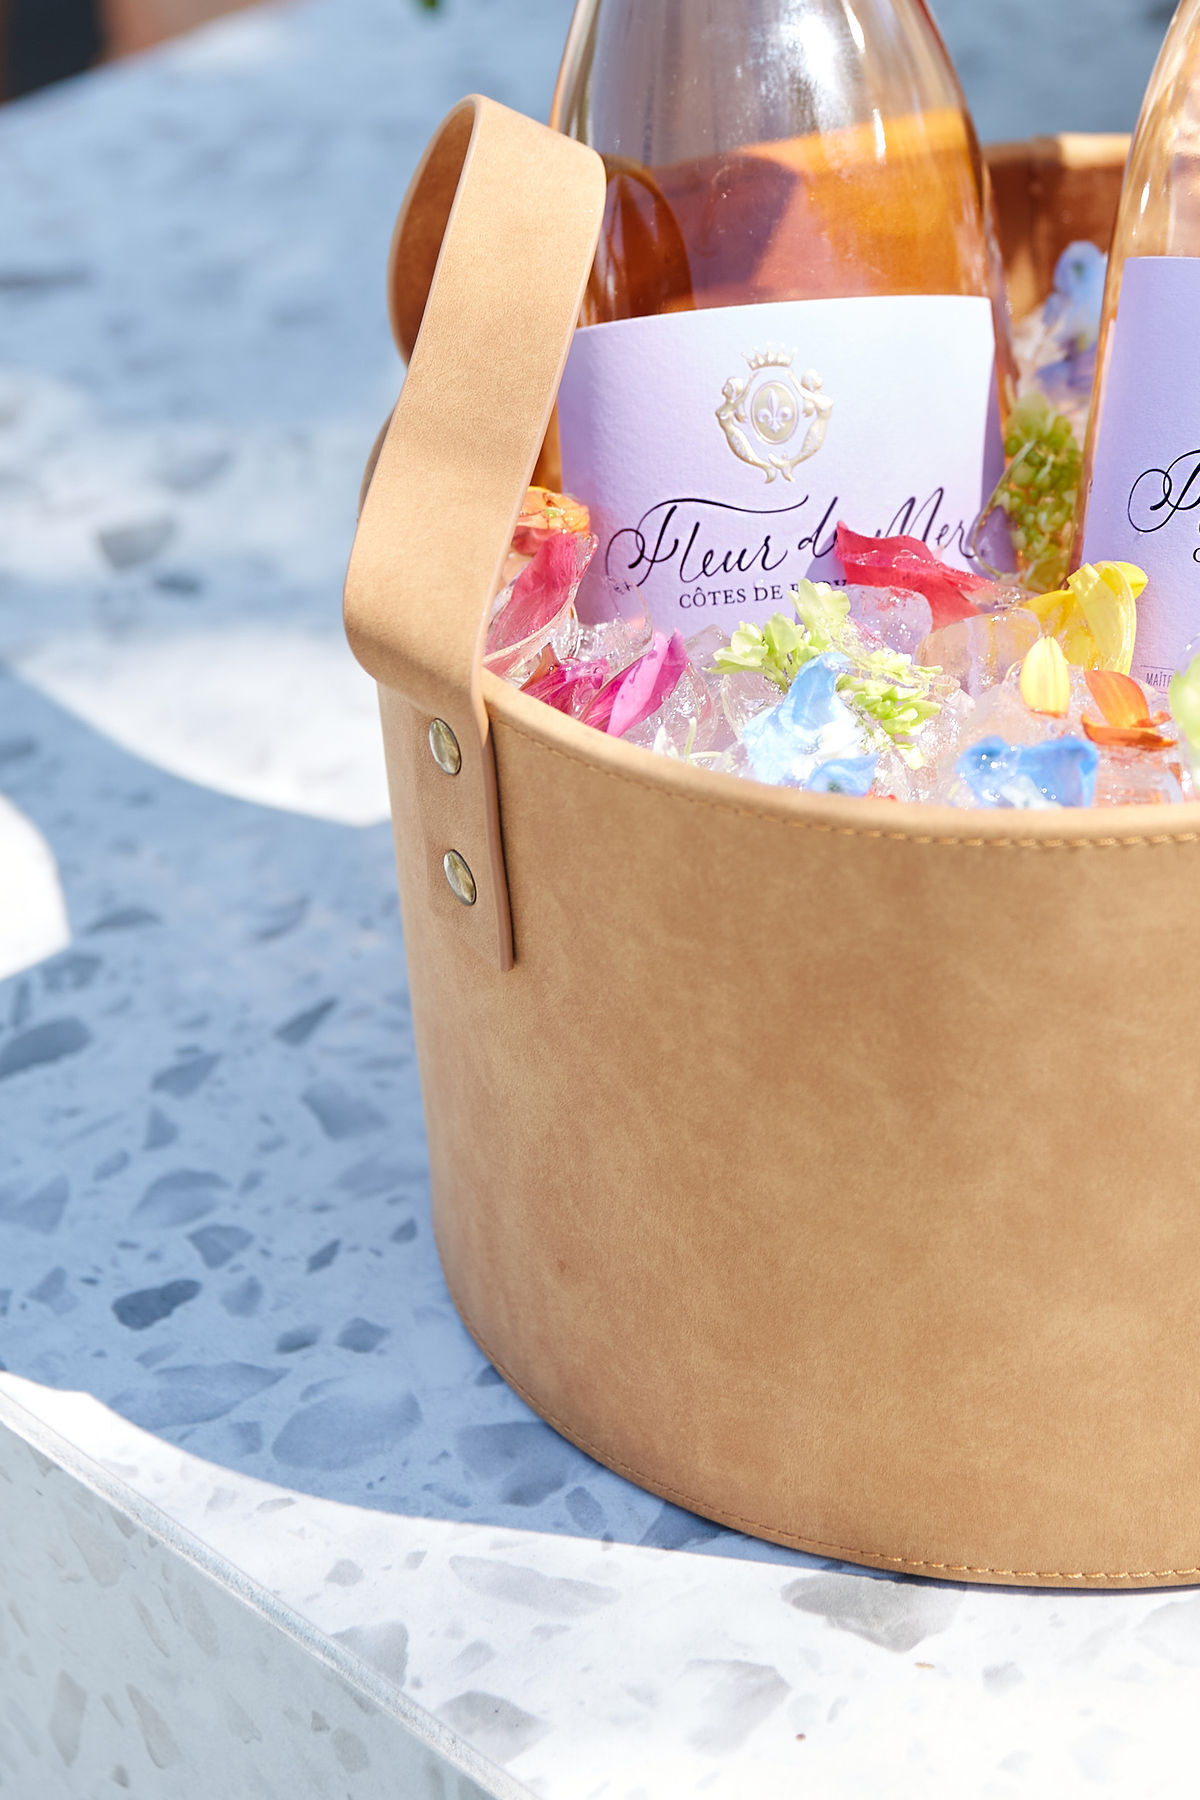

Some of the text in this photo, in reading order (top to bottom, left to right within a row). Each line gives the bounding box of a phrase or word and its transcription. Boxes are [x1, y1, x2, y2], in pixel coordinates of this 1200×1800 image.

[605, 494, 809, 587] Fleur
[797, 496, 839, 558] d
[679, 586, 747, 609] CÔTES
[753, 585, 783, 602] DE
